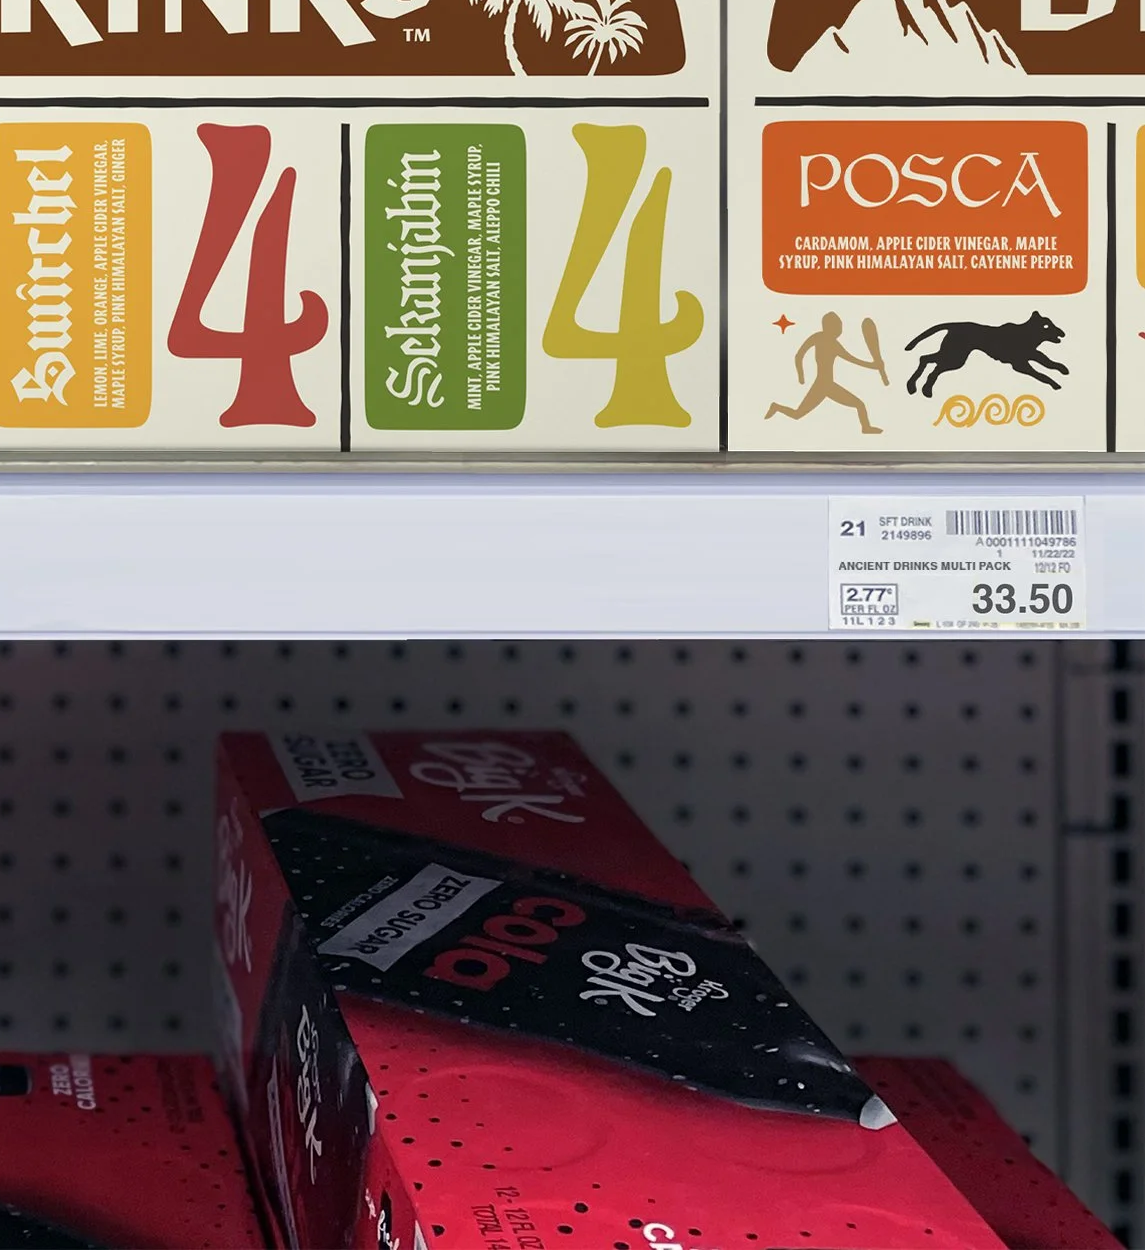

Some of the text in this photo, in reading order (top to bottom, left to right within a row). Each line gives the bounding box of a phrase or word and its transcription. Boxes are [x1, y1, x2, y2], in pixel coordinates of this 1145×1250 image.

[800, 152, 1062, 218] POSCA
[795, 236, 1057, 251] CARDAMOM, APPLE CIDER VINEGAR, MAPLE
[94, 140, 108, 407] LEMON, LIME, ORANGE, APPLE CIDER VINEGAR,
[112, 138, 126, 408] MAPLE SYRUP, PINK HIMALAYAN SALT, GINGER
[167, 123, 329, 428] 4
[467, 143, 483, 410] MINT, APPLE CIDER VINEGAR, MAPLE SYRUP,
[486, 162, 501, 391] PINK HIMALAYAN SALT, ALEPPO CHILI
[542, 123, 704, 428] 4
[779, 254, 1074, 269] SYRUP, PINK HIMALAYAN SALT, CAYENNE PEPPER
[840, 520, 865, 537] 21
[879, 517, 932, 527] SFT DRINK
[881, 530, 932, 541] 2149896
[838, 561, 1012, 571] ANCIENT DRINKS MULTI PACK
[1031, 550, 1075, 559] 11/22/22
[845, 605, 895, 614] PER FL OZ
[972, 583, 1073, 615] 33.50
[354, 875, 472, 955] ZERO SUGAR
[422, 895, 587, 993] cola
[49, 1063, 72, 1097] ZERO
[69, 1053, 97, 1110] CALOR
[471, 1204, 504, 1237] TOTAL
